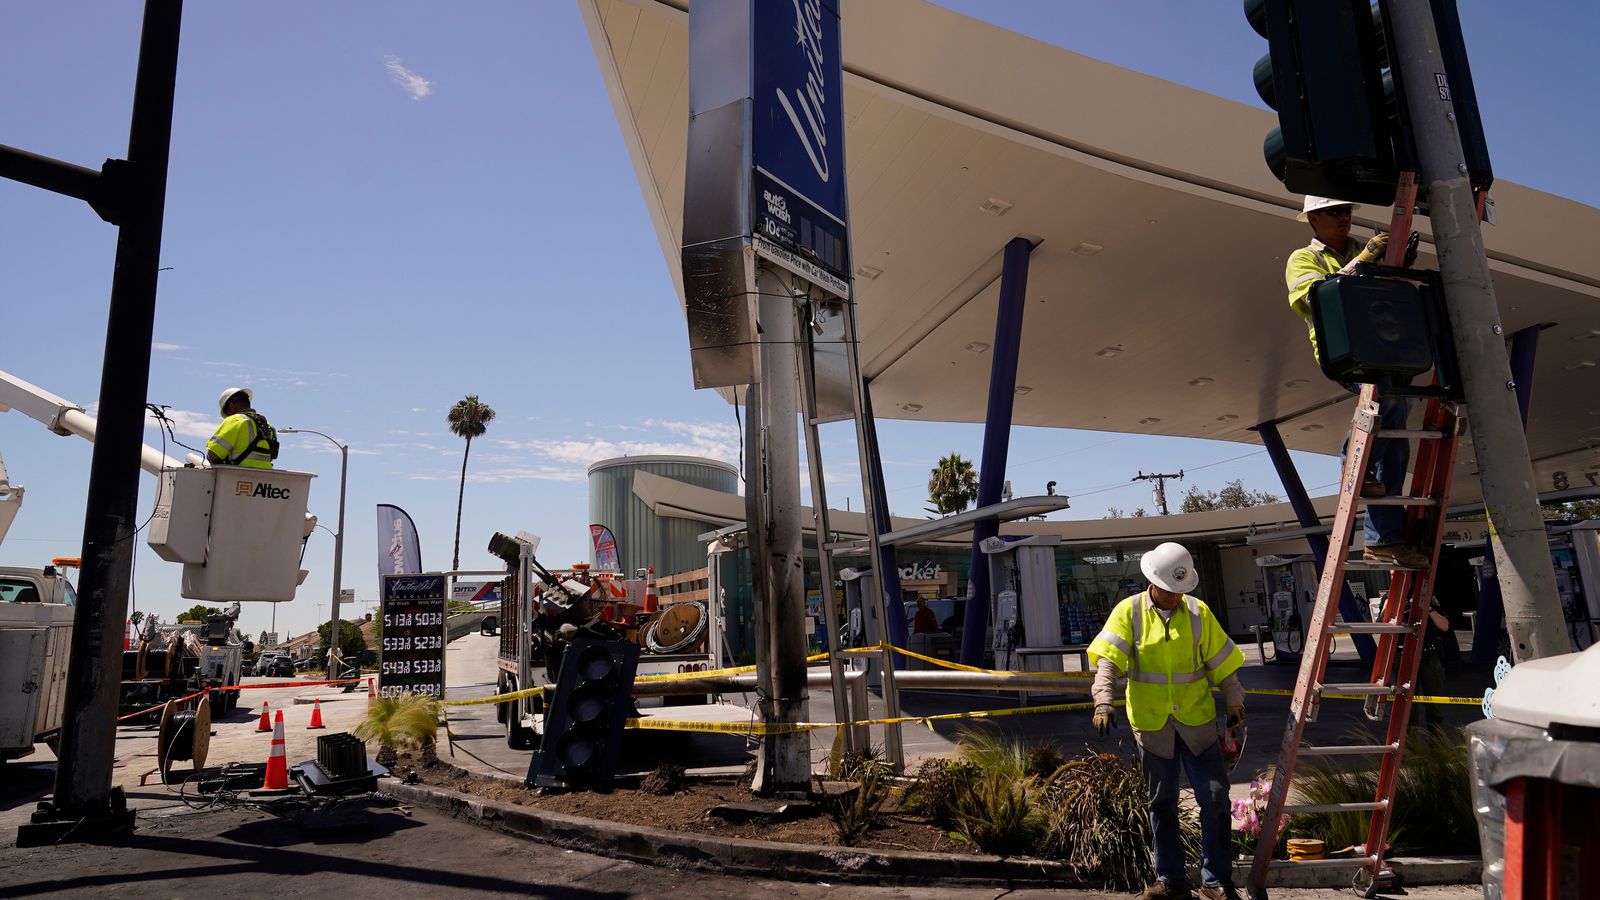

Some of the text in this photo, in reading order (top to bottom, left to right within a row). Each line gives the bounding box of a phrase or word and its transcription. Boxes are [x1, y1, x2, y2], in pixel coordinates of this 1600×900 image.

[763, 190, 787, 210] auto
[767, 202, 791, 224] wash
[770, 245, 790, 262] Gasoline
[790, 255, 801, 268] Price
[801, 261, 811, 273] with
[811, 265, 819, 278] Car
[830, 275, 847, 292] Purchase
[252, 483, 290, 499] Altec
